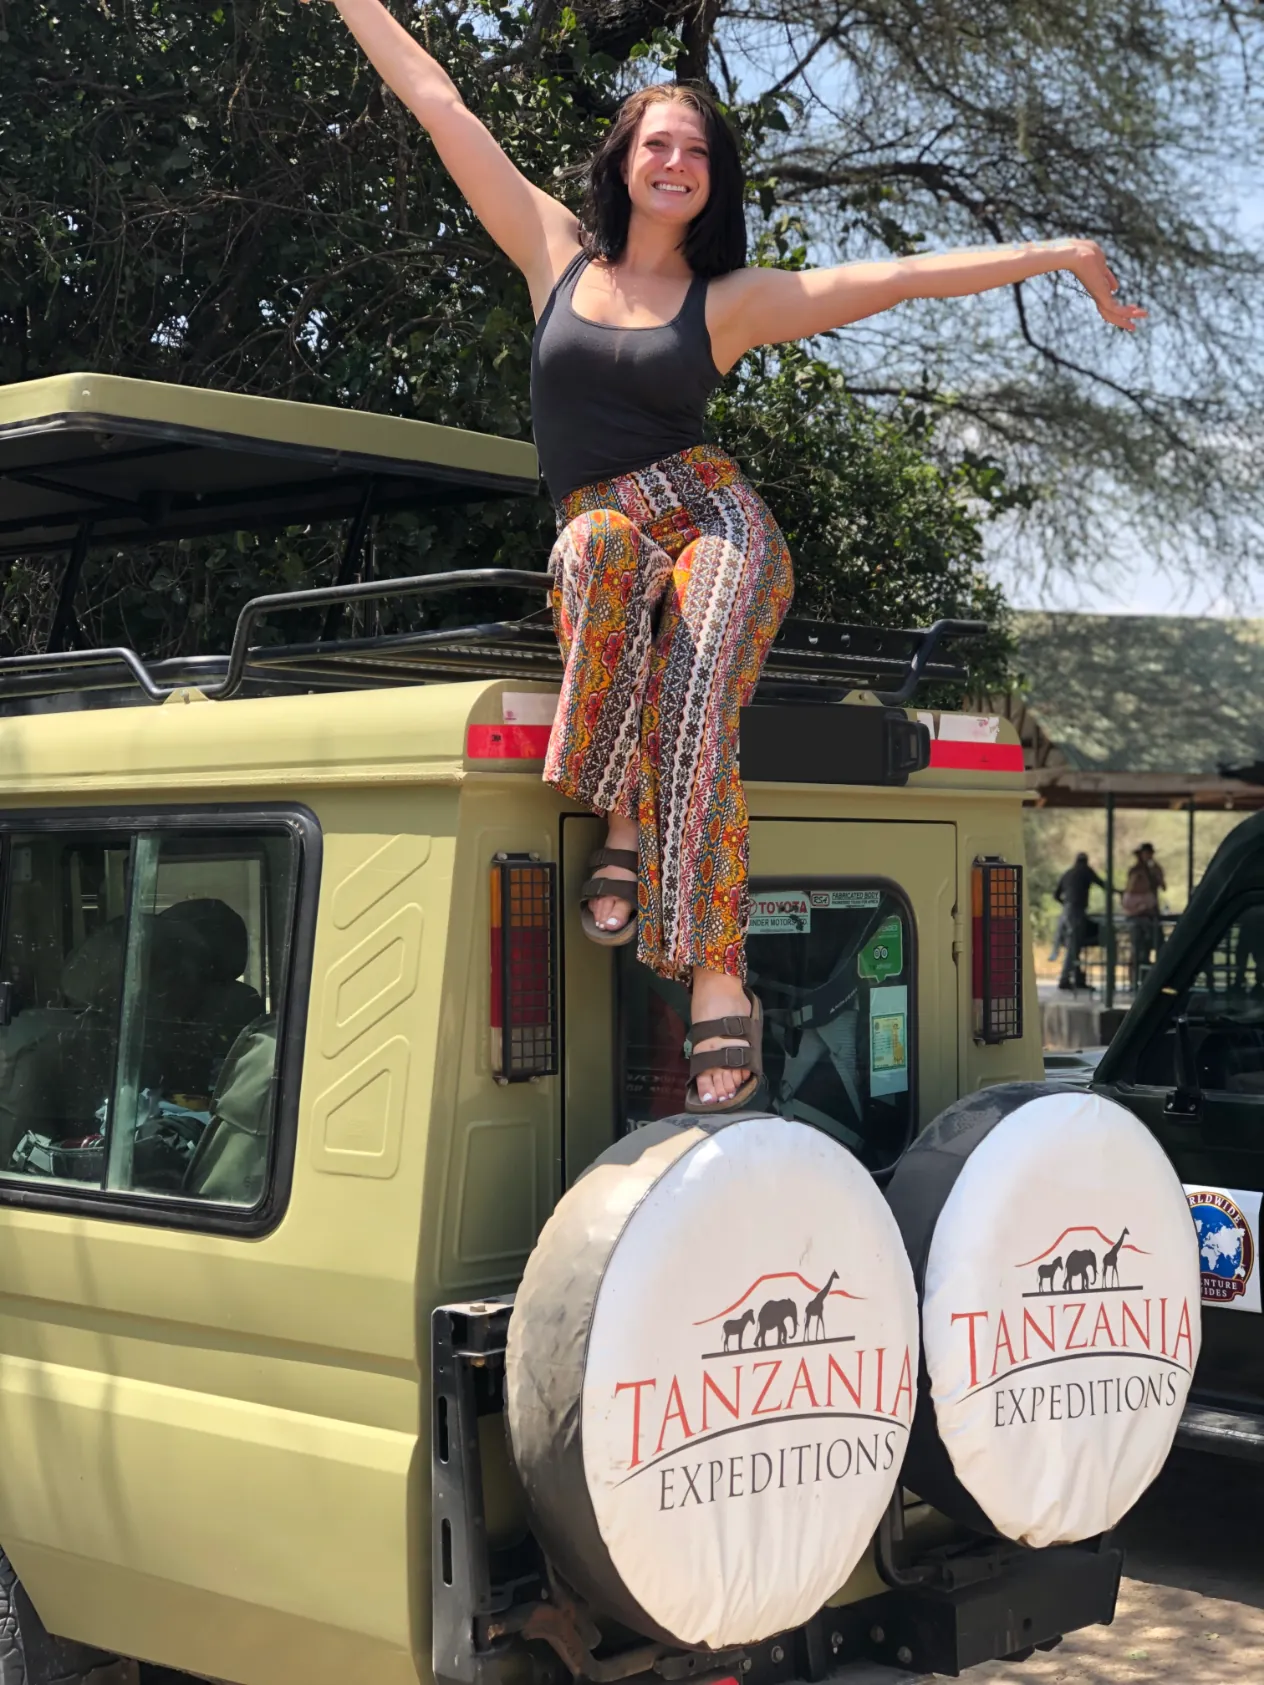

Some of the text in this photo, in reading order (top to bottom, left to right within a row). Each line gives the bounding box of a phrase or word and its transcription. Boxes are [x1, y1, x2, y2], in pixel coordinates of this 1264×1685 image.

[758, 900, 808, 915] TOYOTA
[864, 891, 879, 899] BODY
[1201, 1278, 1238, 1290] NTURE
[1201, 1287, 1227, 1298] IDES
[952, 1296, 1193, 1390] TANZANIA
[614, 1344, 914, 1471] TANZANIA
[993, 1371, 1177, 1428] EXPEDITIONS
[658, 1430, 897, 1512] EXPEDITIONS
